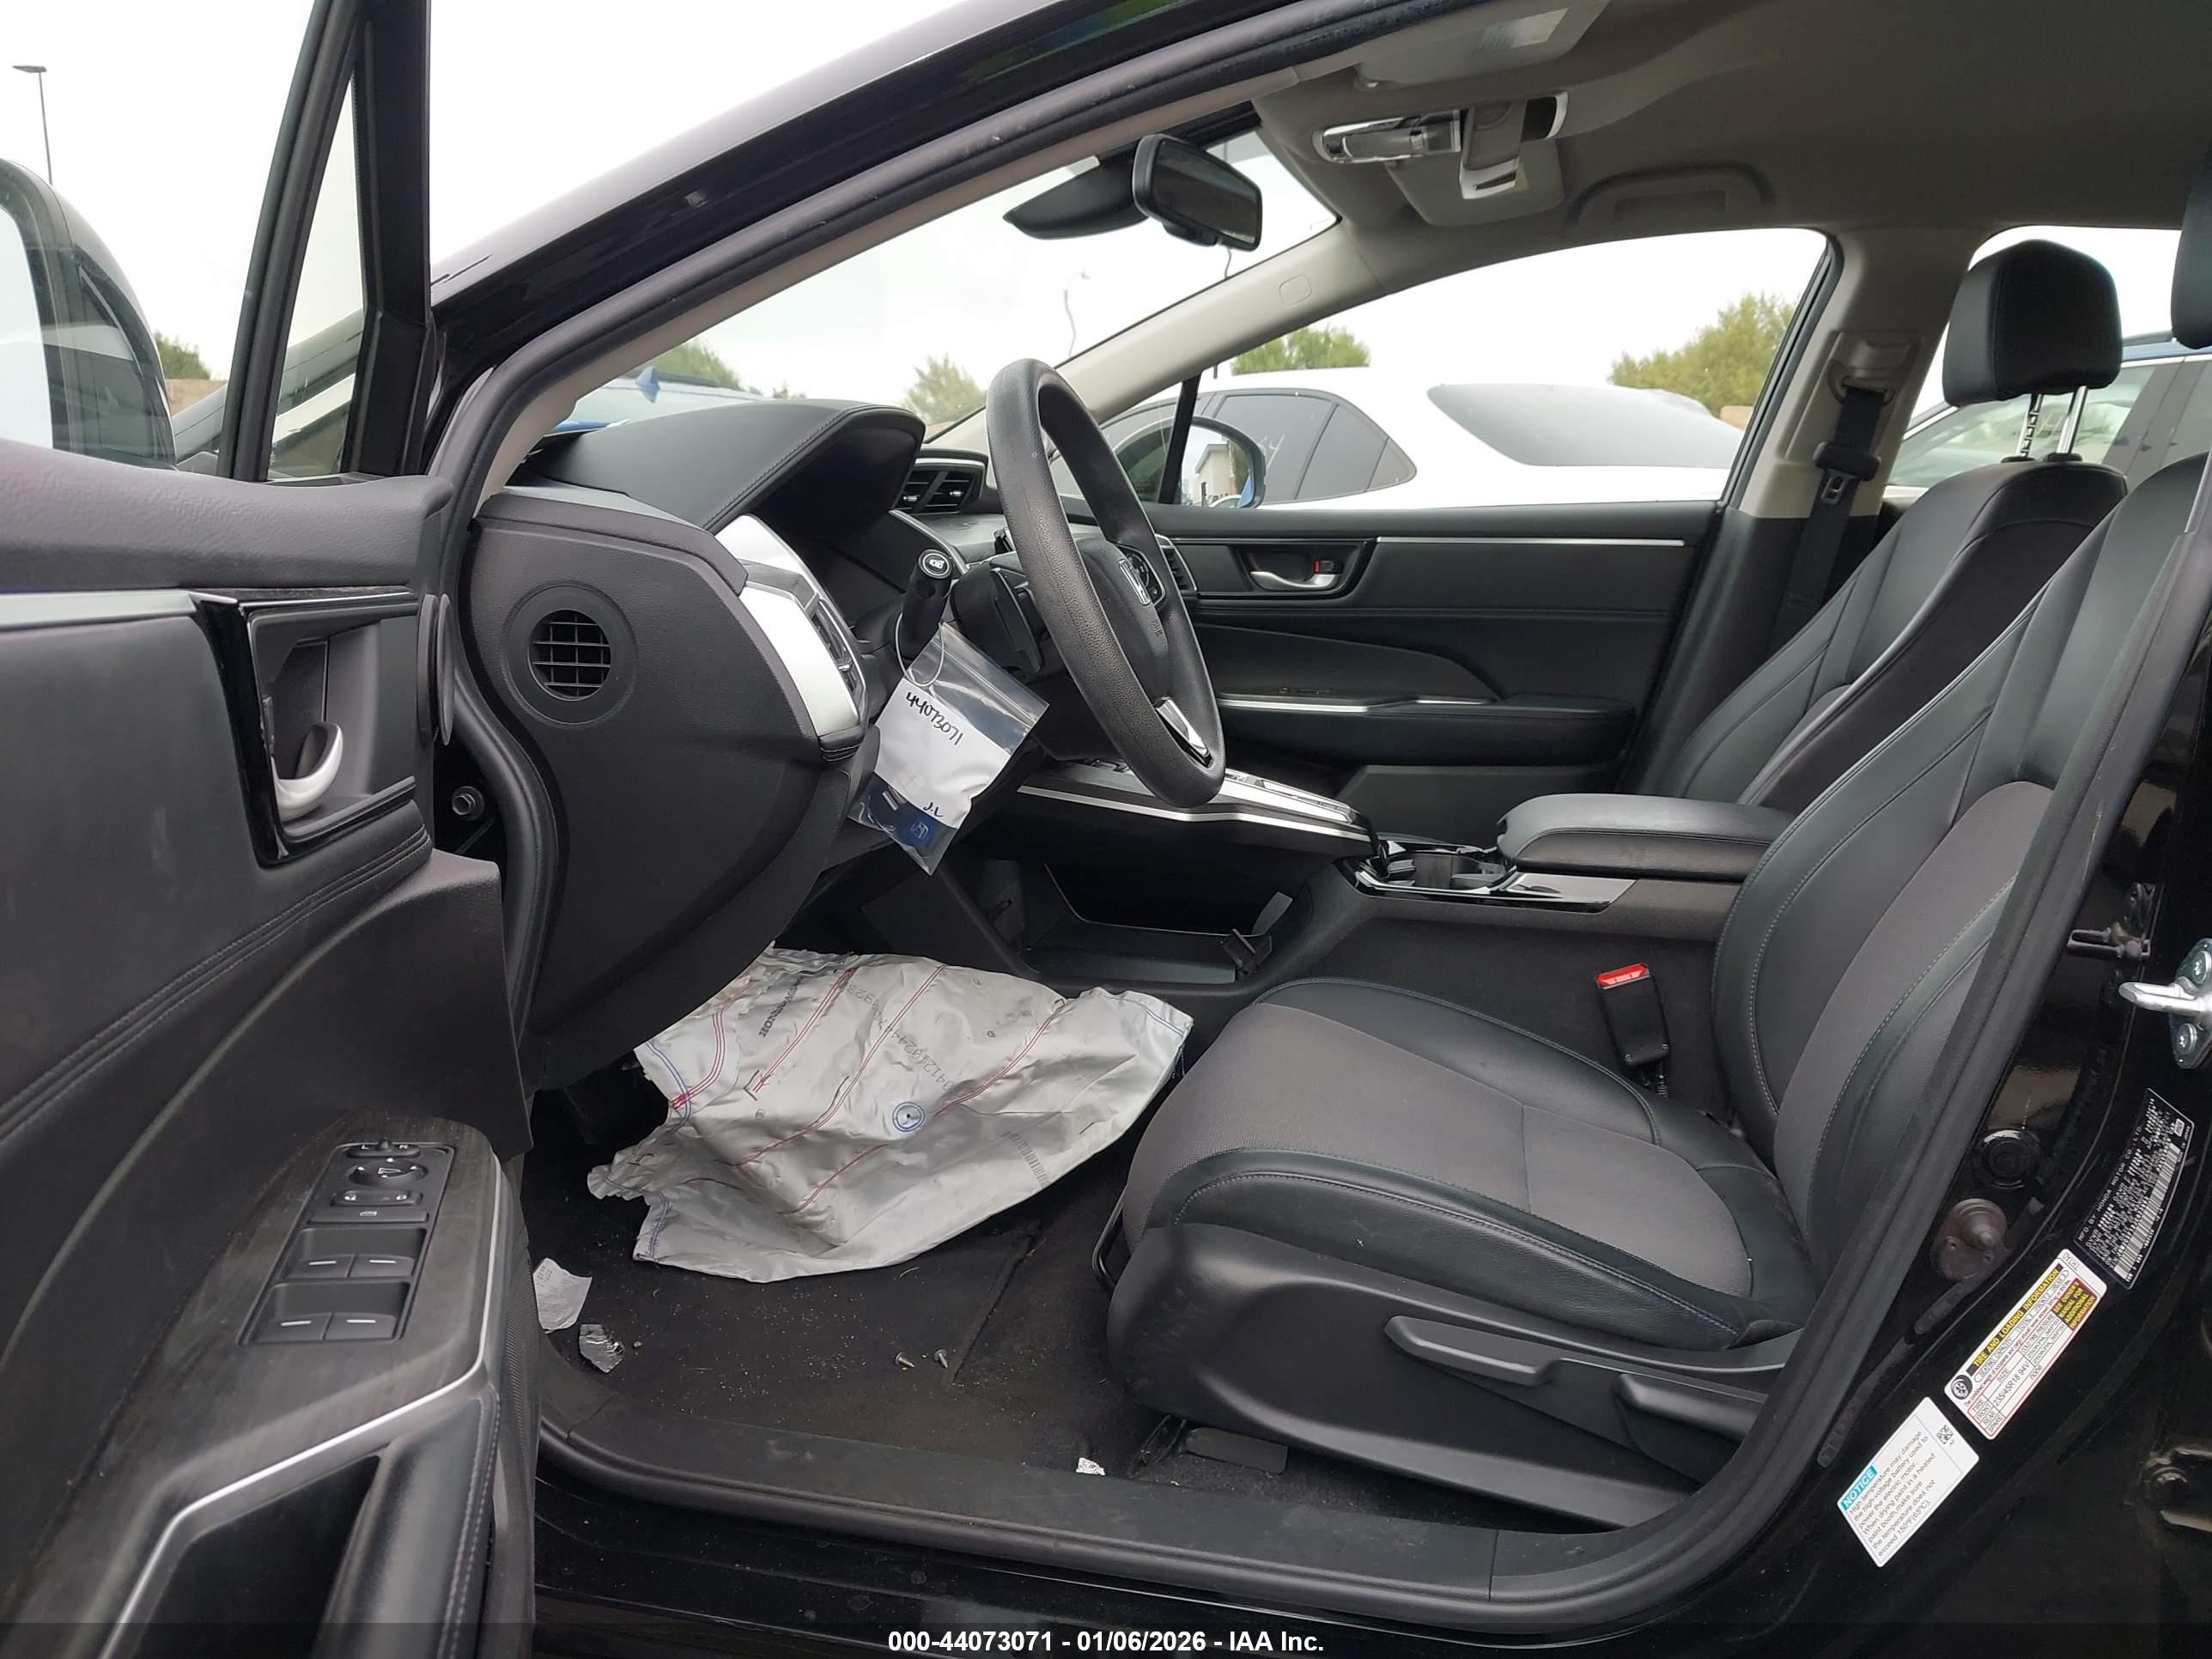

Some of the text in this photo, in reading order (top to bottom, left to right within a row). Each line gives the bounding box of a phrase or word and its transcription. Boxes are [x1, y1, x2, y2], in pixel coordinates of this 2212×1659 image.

[904, 691, 963, 745] 44073071
[2095, 1186, 2112, 1213] HONDA
[2110, 1160, 2126, 1188] MOTOR
[1972, 1350, 1988, 1367] TIRE
[1985, 1336, 2000, 1353] AND
[1997, 1308, 2024, 1339] LOADING
[2021, 1267, 2059, 1310] INFORMATION
[2057, 1297, 2075, 1318] MANUAL
[2072, 1286, 2083, 1298] FOR
[2063, 1291, 2088, 1323] ADDITIONAL
[2069, 1294, 2095, 1328] INFORMATION
[1972, 1398, 1984, 1413] TIRE
[1996, 1367, 2009, 1382] SIZE
[1976, 1402, 1991, 1421] FRONT
[1992, 1372, 2021, 1407] 235/45R18
[2017, 1359, 2030, 1376] 94V
[1983, 1409, 1996, 1425] REAR
[1987, 1364, 2042, 1433] SPARE none
[1842, 1468, 1875, 1508] NOTICE
[1849, 1430, 1922, 1516] High temperature may damage
[1853, 1434, 1929, 1522] the high-voltage battery used to
[1858, 1460, 1917, 1529] power the electric motor.
[1862, 1515, 1879, 1535] When
[1877, 1498, 1895, 1520] drying
[1893, 1483, 1908, 1501] paint
[1905, 1477, 1913, 1486] in
[1916, 1451, 1936, 1474] heated
[1868, 1525, 1881, 1543] paint
[1894, 1492, 1911, 1511] make
[1910, 1480, 1923, 1495] sure
[1872, 1479, 1936, 1550] the temperature does not
[1877, 1533, 1898, 1558] exceed
